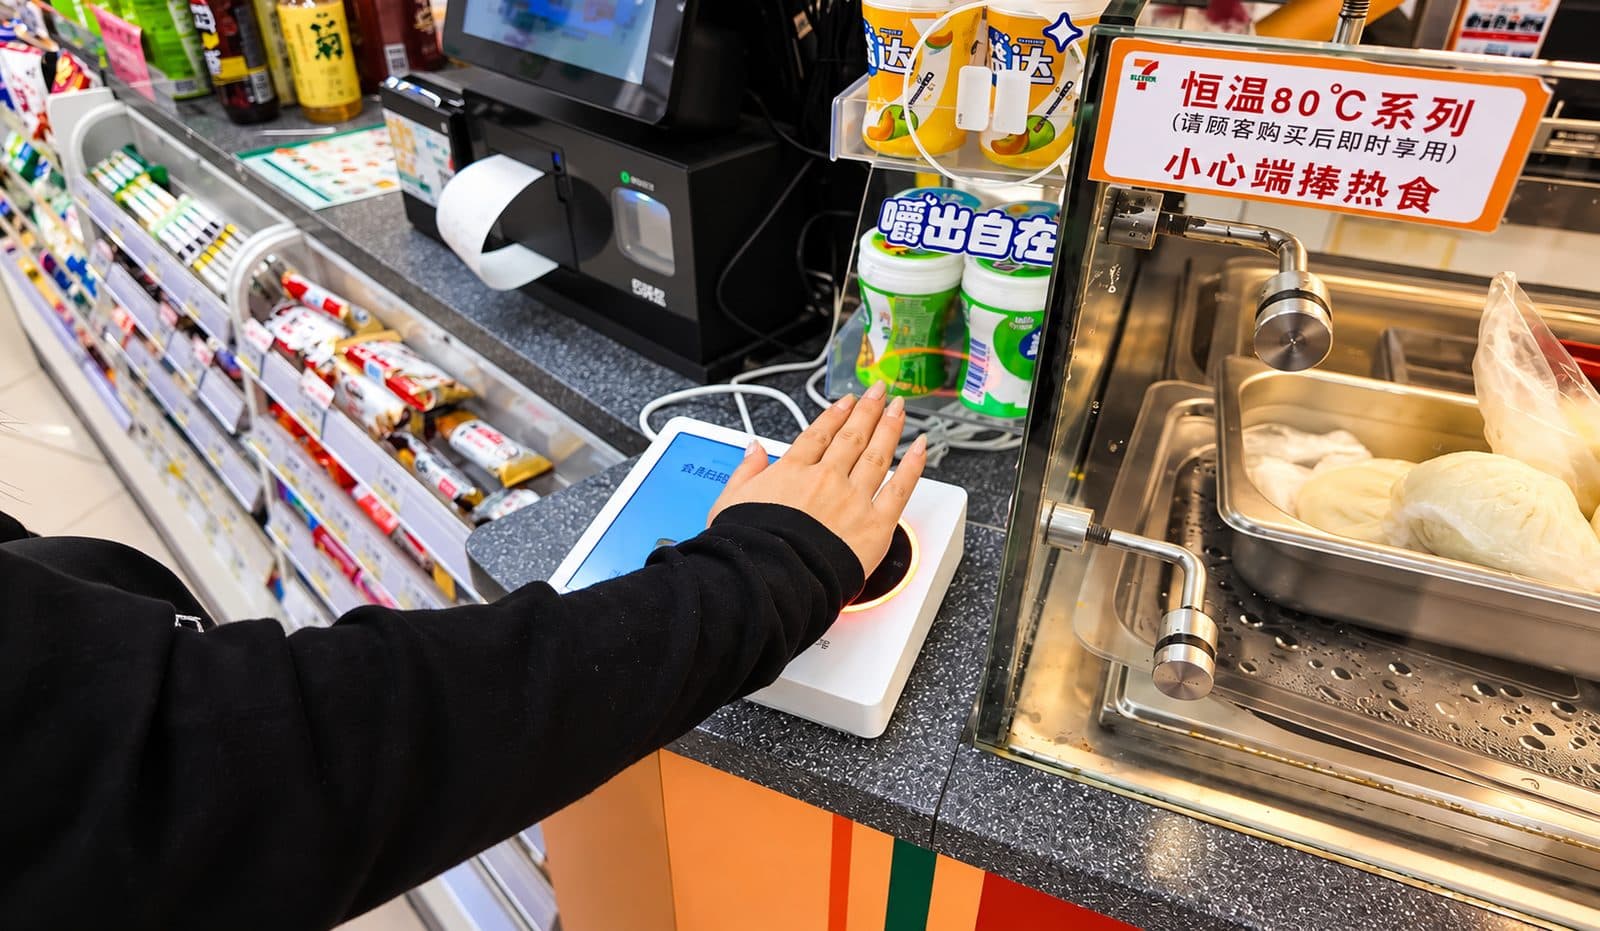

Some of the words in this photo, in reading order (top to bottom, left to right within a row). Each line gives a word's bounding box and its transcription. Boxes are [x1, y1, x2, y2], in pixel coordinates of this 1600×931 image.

[310, 20, 343, 60] 菊
[1164, 147, 1440, 213] 小心端捧热食
[880, 193, 1057, 264] 嚼出自在
